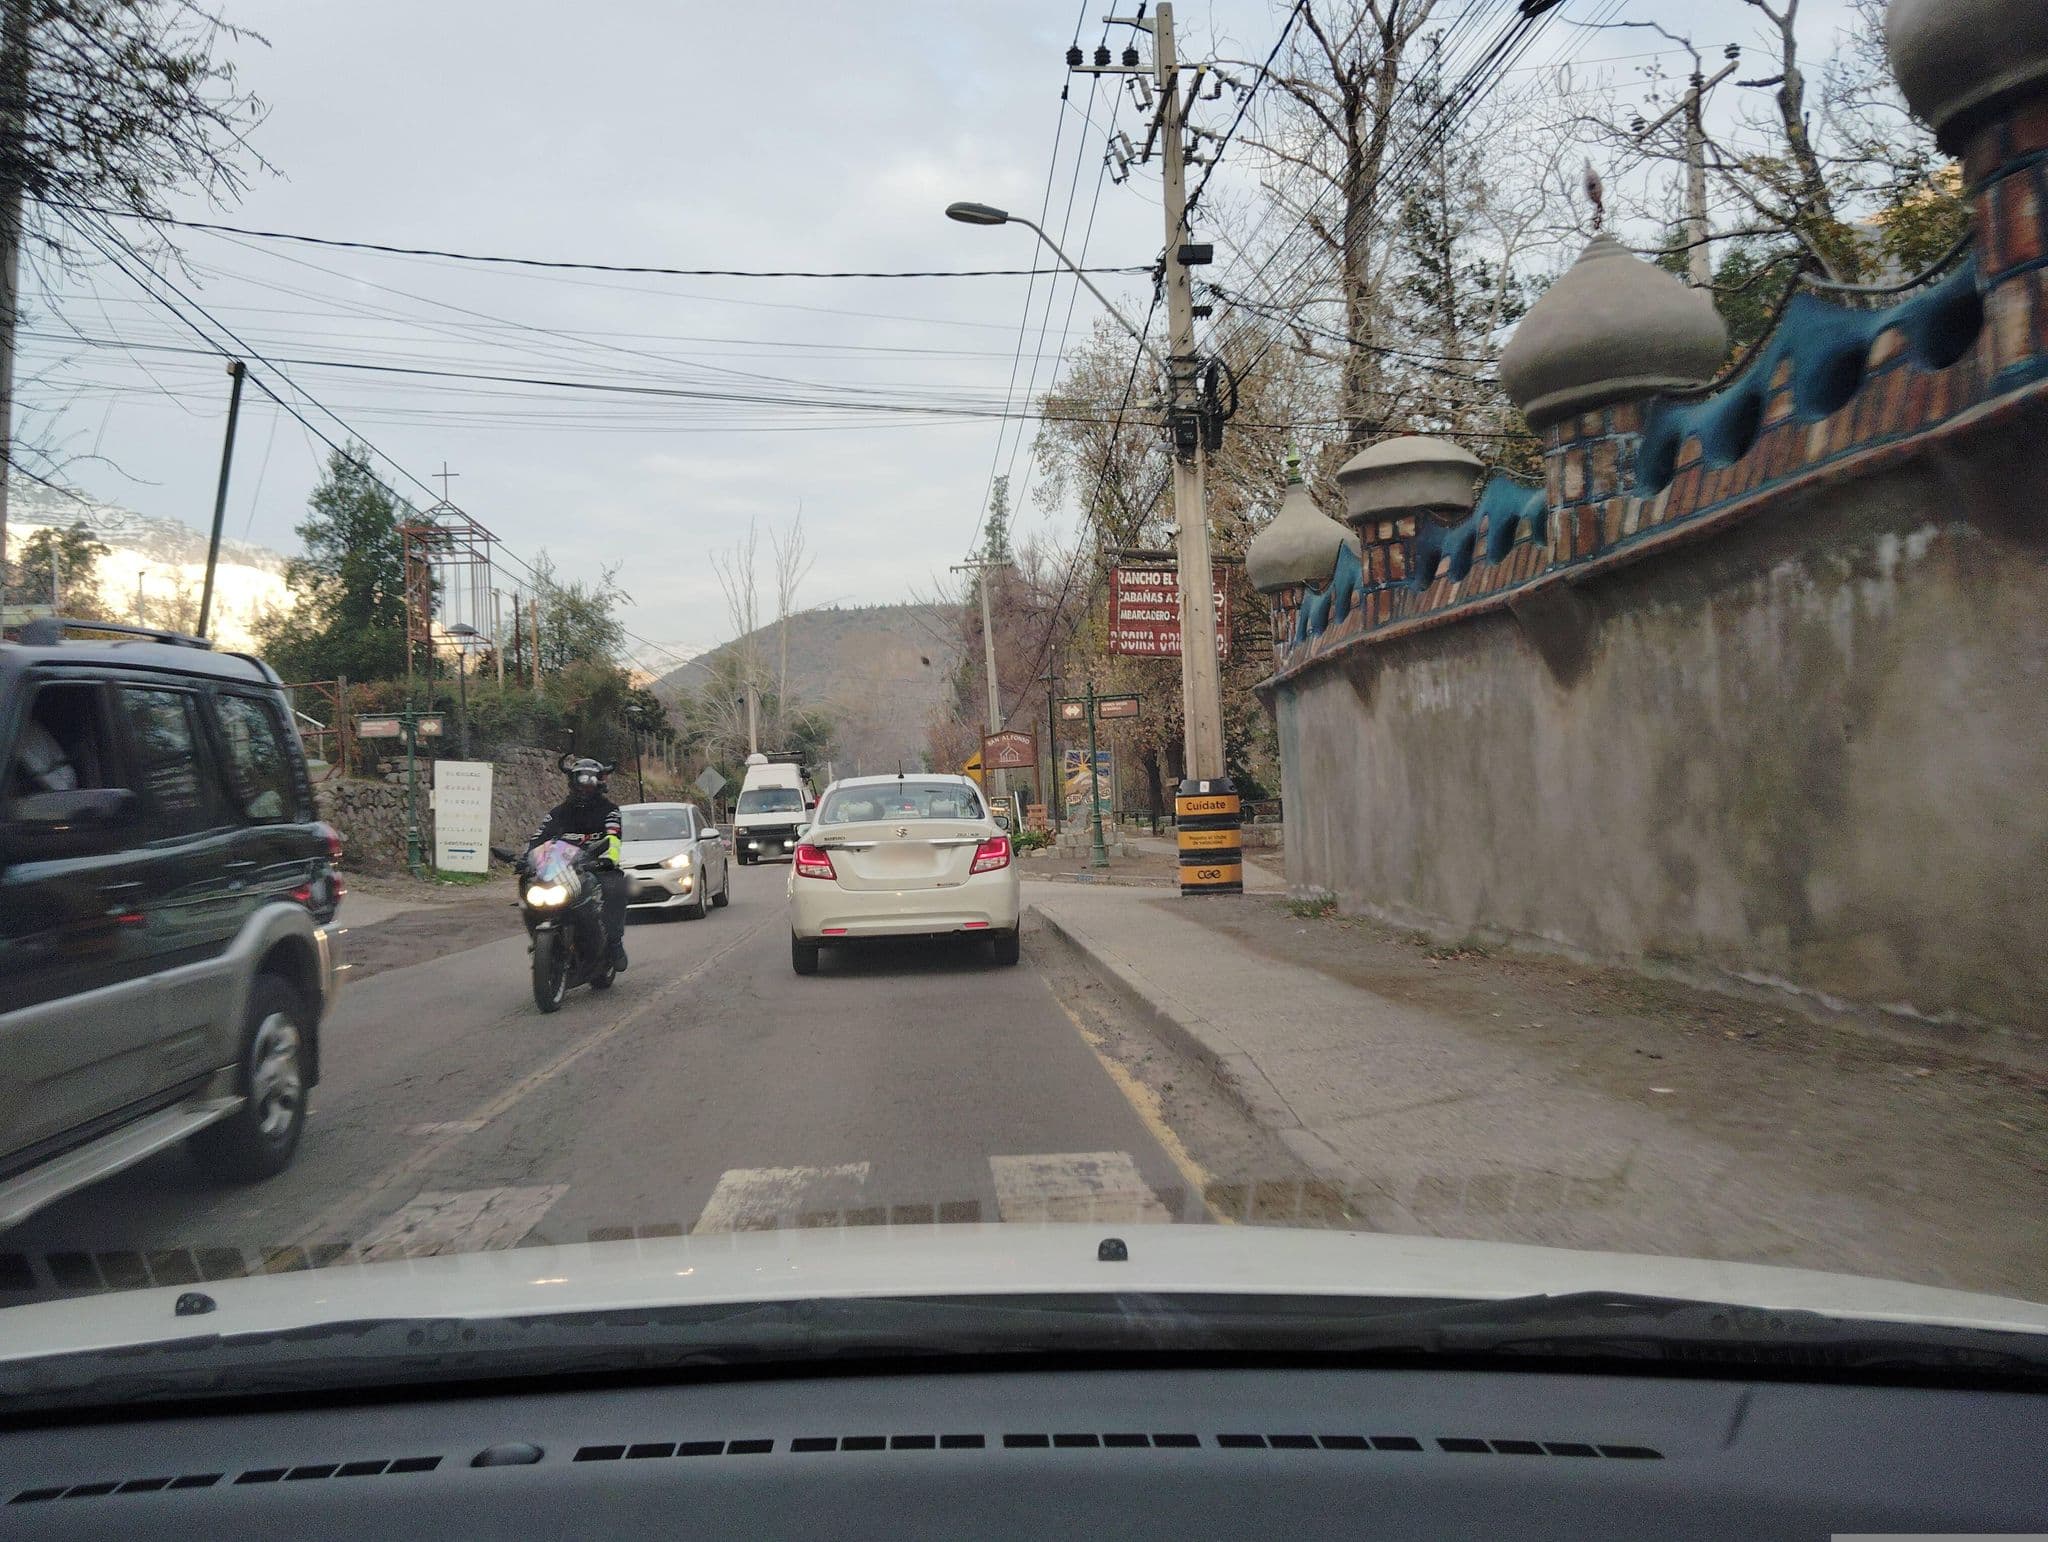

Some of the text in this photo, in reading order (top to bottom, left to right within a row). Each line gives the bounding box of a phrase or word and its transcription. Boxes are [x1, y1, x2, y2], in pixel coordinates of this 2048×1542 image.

[1119, 572, 1160, 585] RANCHO
[1162, 572, 1173, 585] EL
[1118, 589, 1163, 603] CABAÑAS
[1002, 735, 1030, 744] ALFONSO
